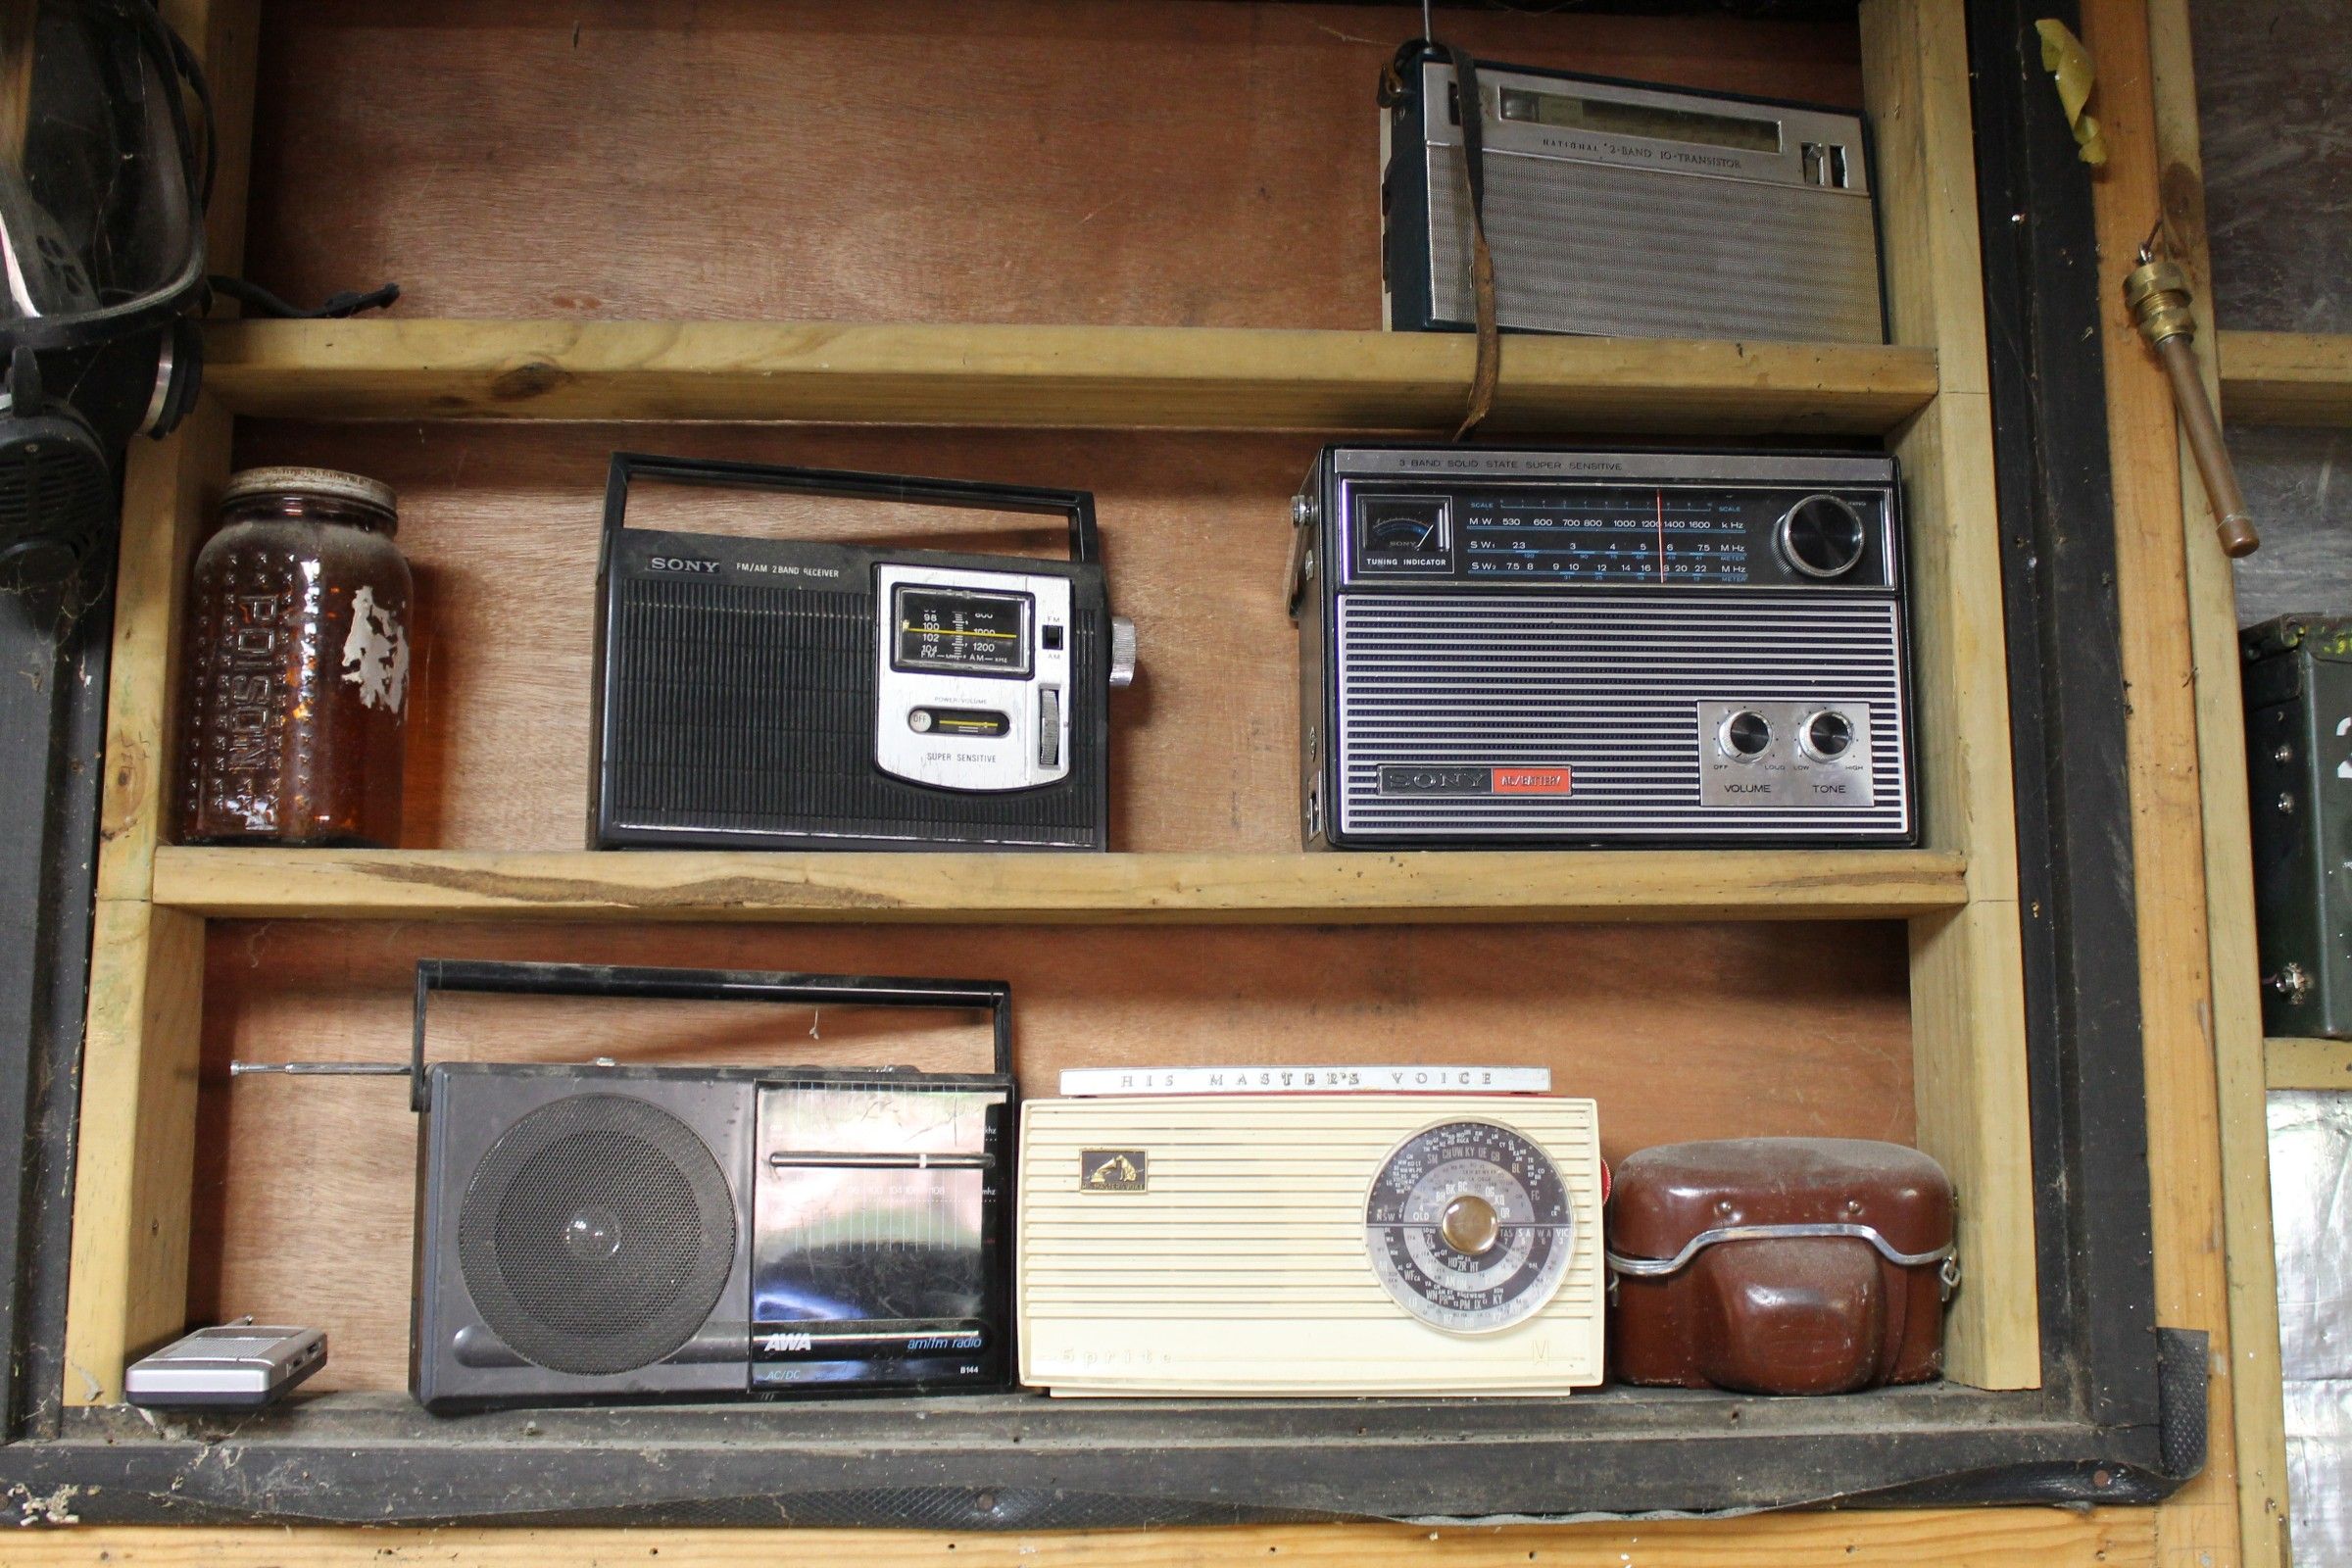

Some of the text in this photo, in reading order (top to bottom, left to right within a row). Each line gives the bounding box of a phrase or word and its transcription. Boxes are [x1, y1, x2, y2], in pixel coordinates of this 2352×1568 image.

[1543, 138, 1598, 152] NATIONAL
[1398, 459, 1405, 467] 3
[1447, 460, 1479, 468] SOLID
[1525, 461, 1562, 469] SUPER
[1569, 462, 1623, 471] SENSITIVE
[1502, 517, 1521, 526] 530
[1562, 518, 1581, 527] 700
[1613, 519, 1637, 528] 1000
[651, 557, 720, 573] SONY
[736, 562, 768, 573] FM/AM
[803, 567, 840, 578] RECEIVER
[1552, 563, 1560, 571] 9
[923, 613, 937, 622] 98
[922, 633, 940, 643] 102
[921, 642, 996, 654] 104 1200
[969, 653, 985, 662] AM
[228, 595, 278, 772] POISON
[912, 714, 927, 723] OFF
[927, 752, 997, 763] SUPER SENSITIVE
[1389, 772, 1486, 789] SONY
[1724, 784, 1772, 794] VOLUME
[1812, 785, 1846, 794] TONE
[1120, 1072, 1492, 1088] HIS MASTER'S VOICE
[1412, 1211, 1430, 1222] QLD
[1555, 1228, 1569, 1238] VIC
[763, 1332, 812, 1352] AWA
[907, 1337, 982, 1350] am/fm radio
[765, 1370, 801, 1381] AC/DC
[959, 1365, 979, 1375] B144
